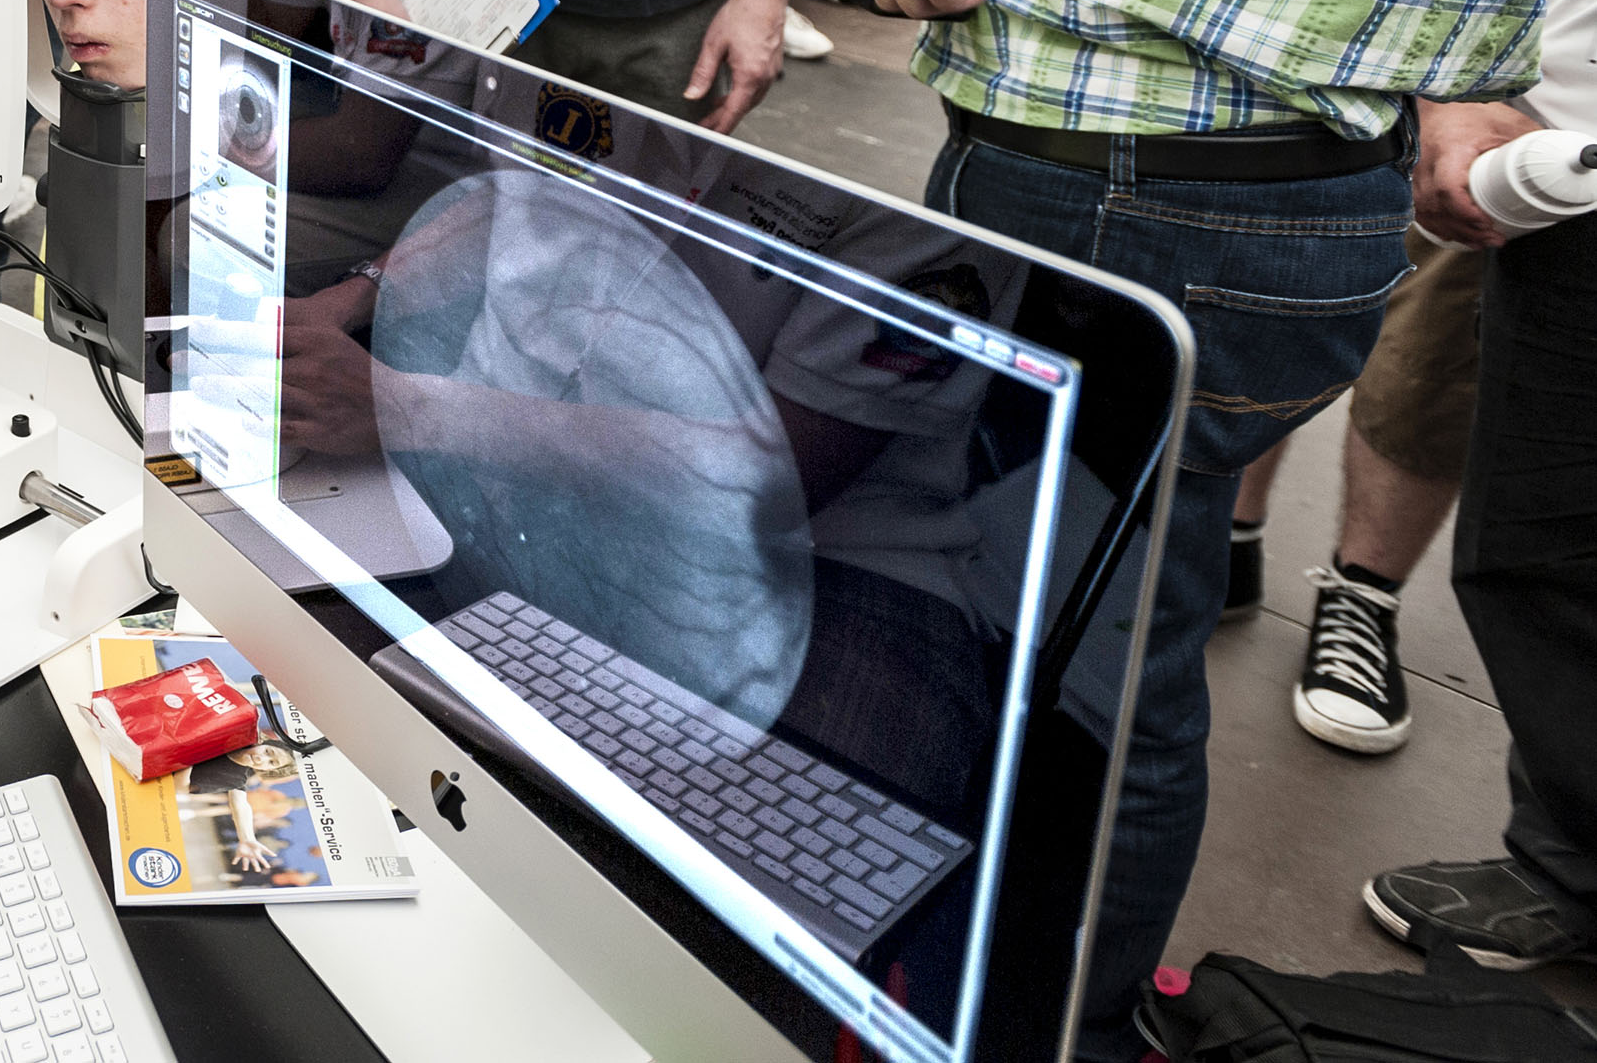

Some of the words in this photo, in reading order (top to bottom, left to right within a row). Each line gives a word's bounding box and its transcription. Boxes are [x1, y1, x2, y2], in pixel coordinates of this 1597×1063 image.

[178, 0, 215, 20] easyscan
[181, 662, 237, 715] REWE
[148, 856, 157, 880] stark
